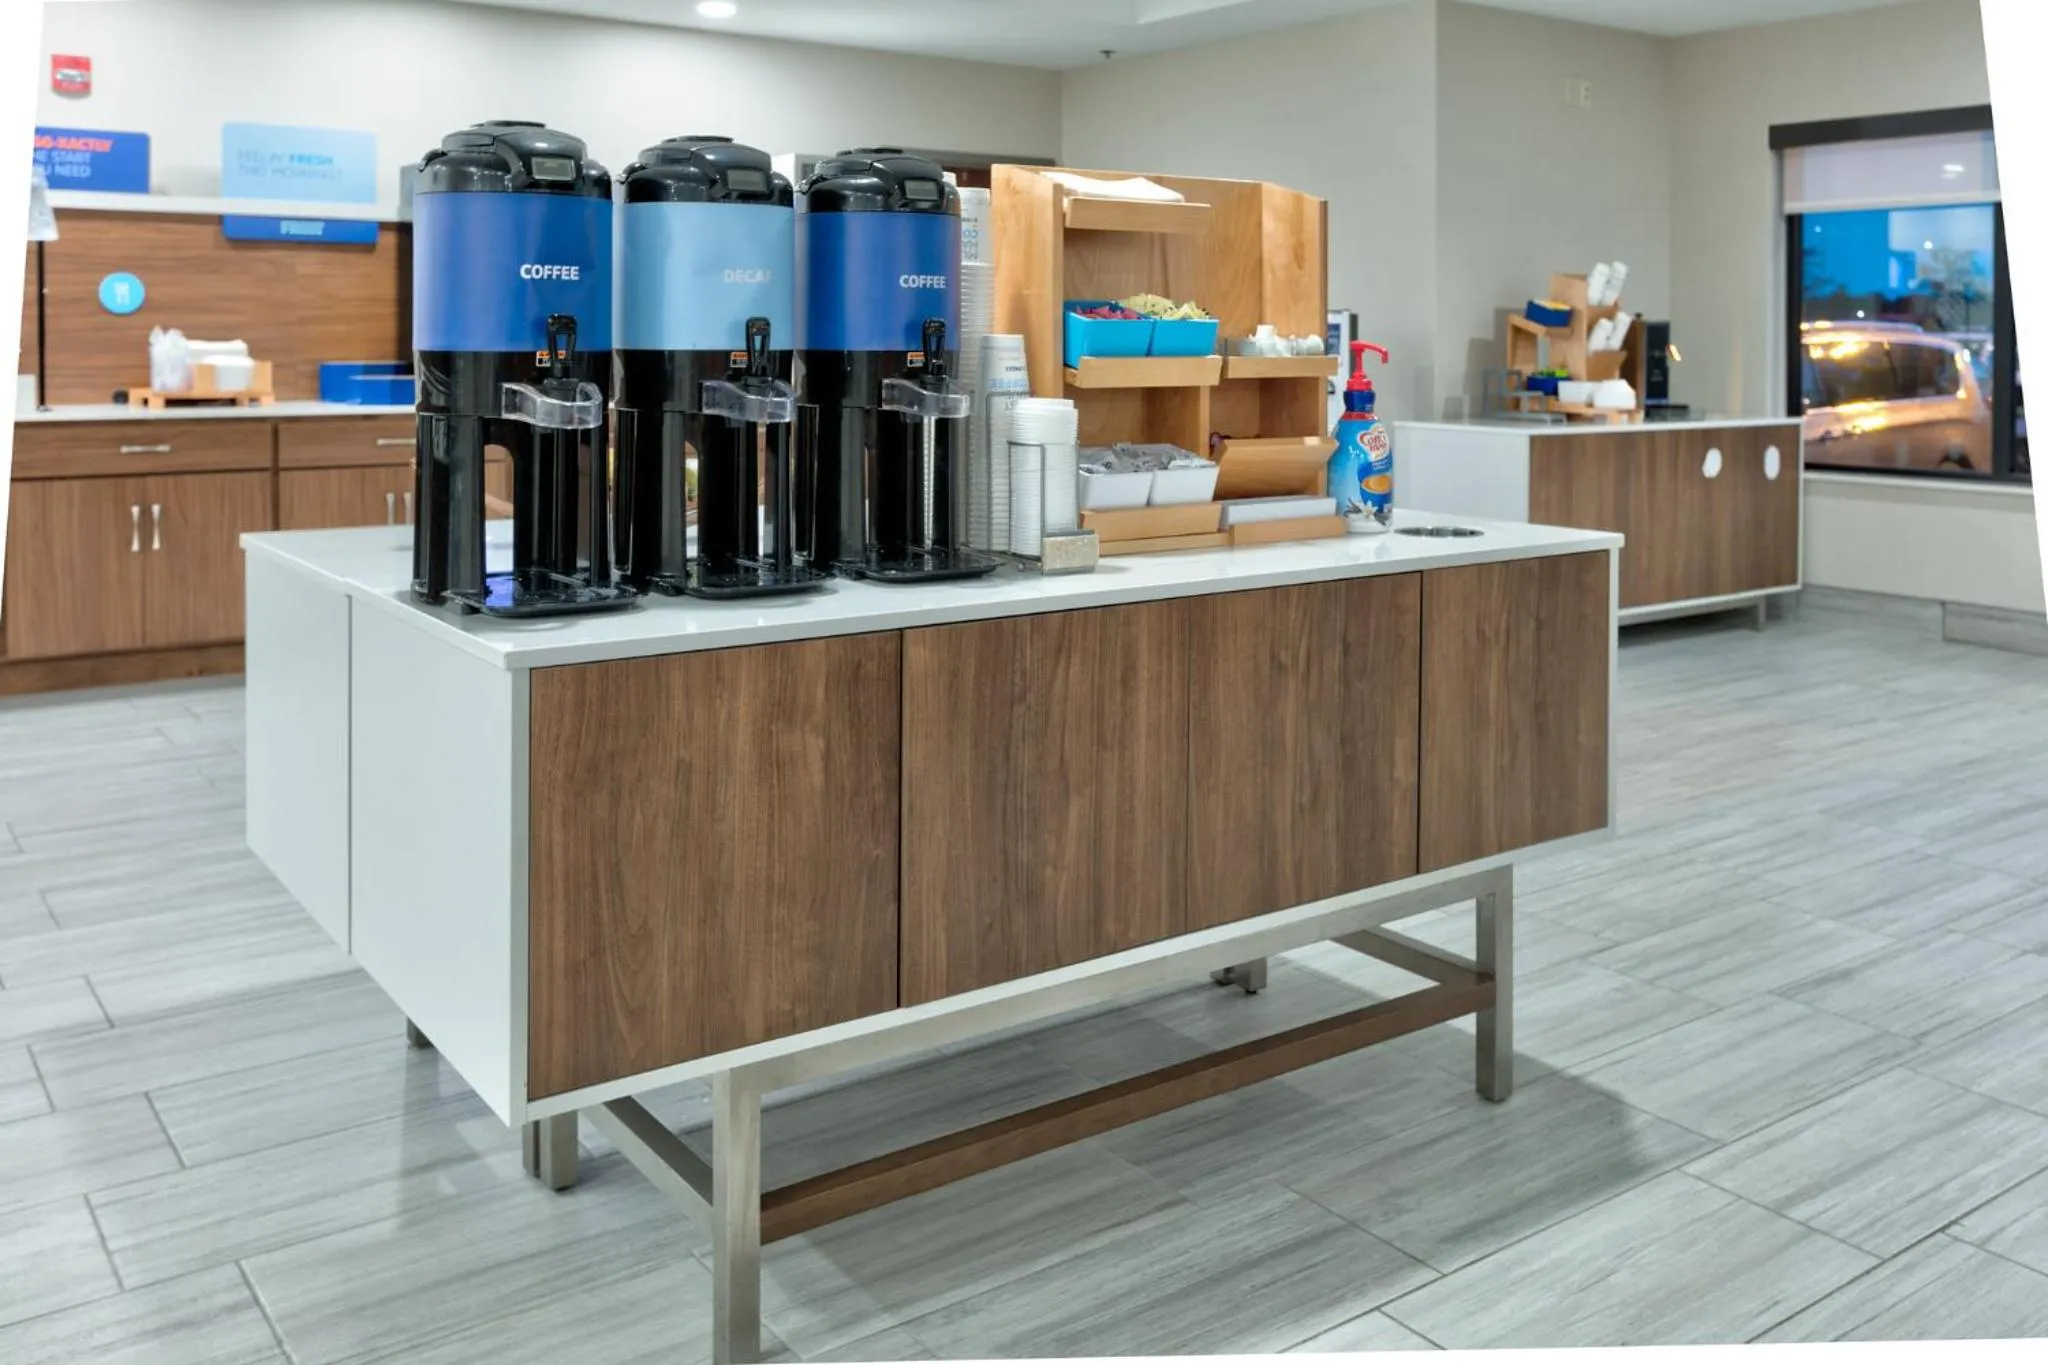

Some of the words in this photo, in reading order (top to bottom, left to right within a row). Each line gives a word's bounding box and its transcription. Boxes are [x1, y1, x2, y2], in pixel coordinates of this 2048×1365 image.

[289, 152, 334, 167] FRESH
[55, 164, 91, 178] NEED
[520, 263, 580, 281] COFFEE
[899, 274, 947, 289] COFFEE
